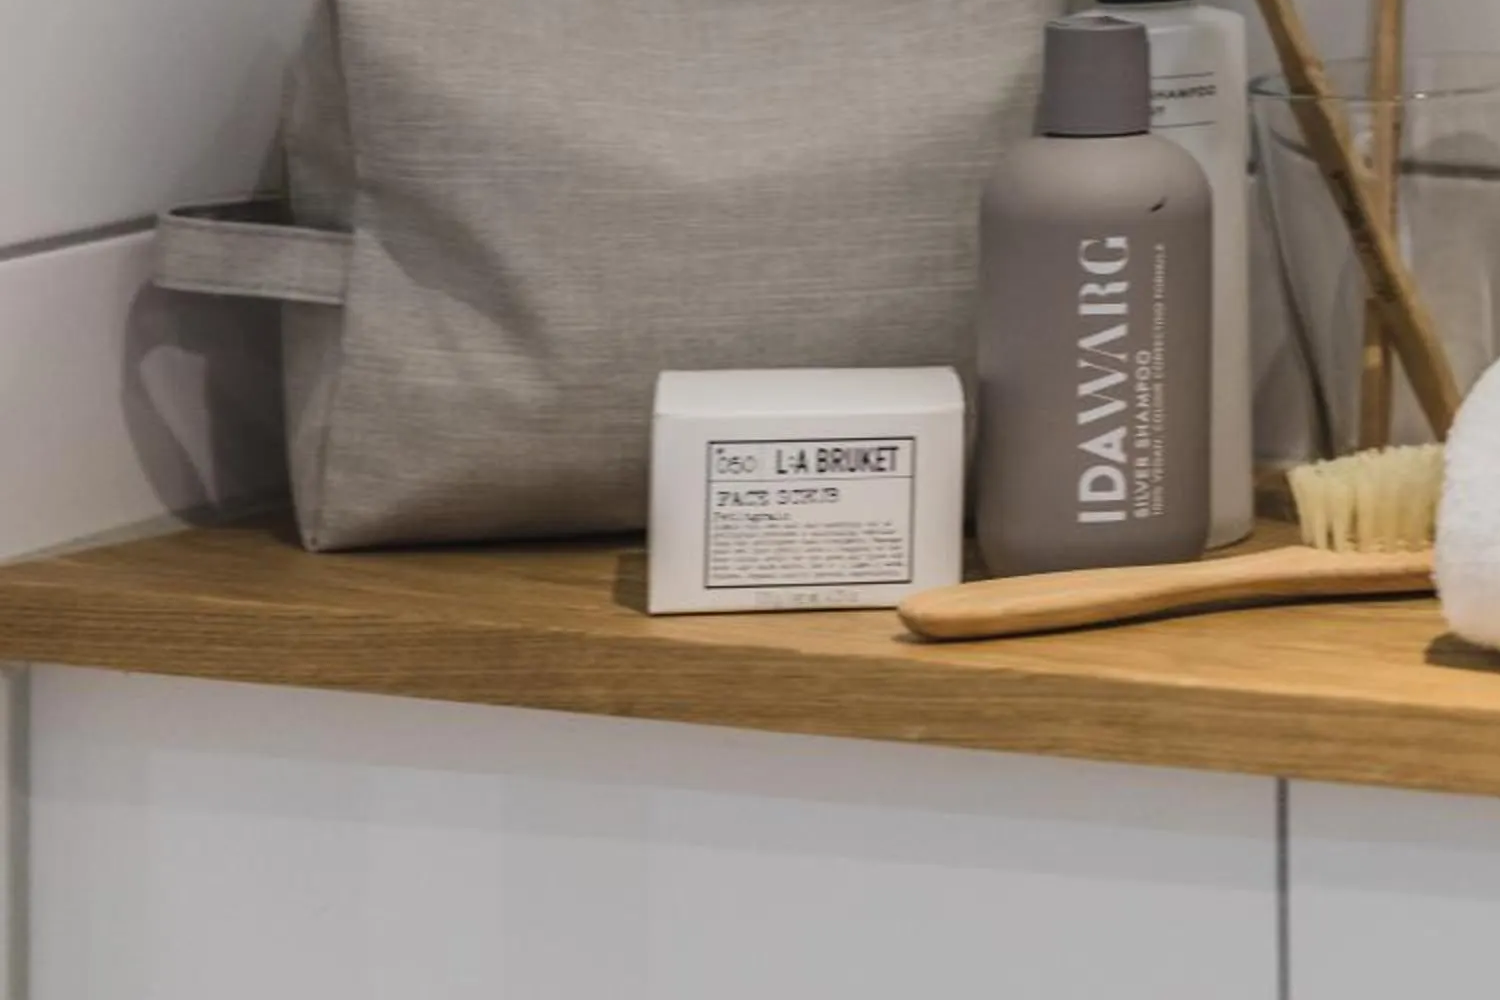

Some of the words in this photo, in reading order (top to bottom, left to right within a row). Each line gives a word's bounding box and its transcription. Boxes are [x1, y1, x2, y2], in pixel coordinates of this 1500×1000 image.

[1134, 350, 1151, 449] SHAMPOO
[816, 446, 899, 473] BRUKET
[1134, 456, 1151, 518] SILVER
